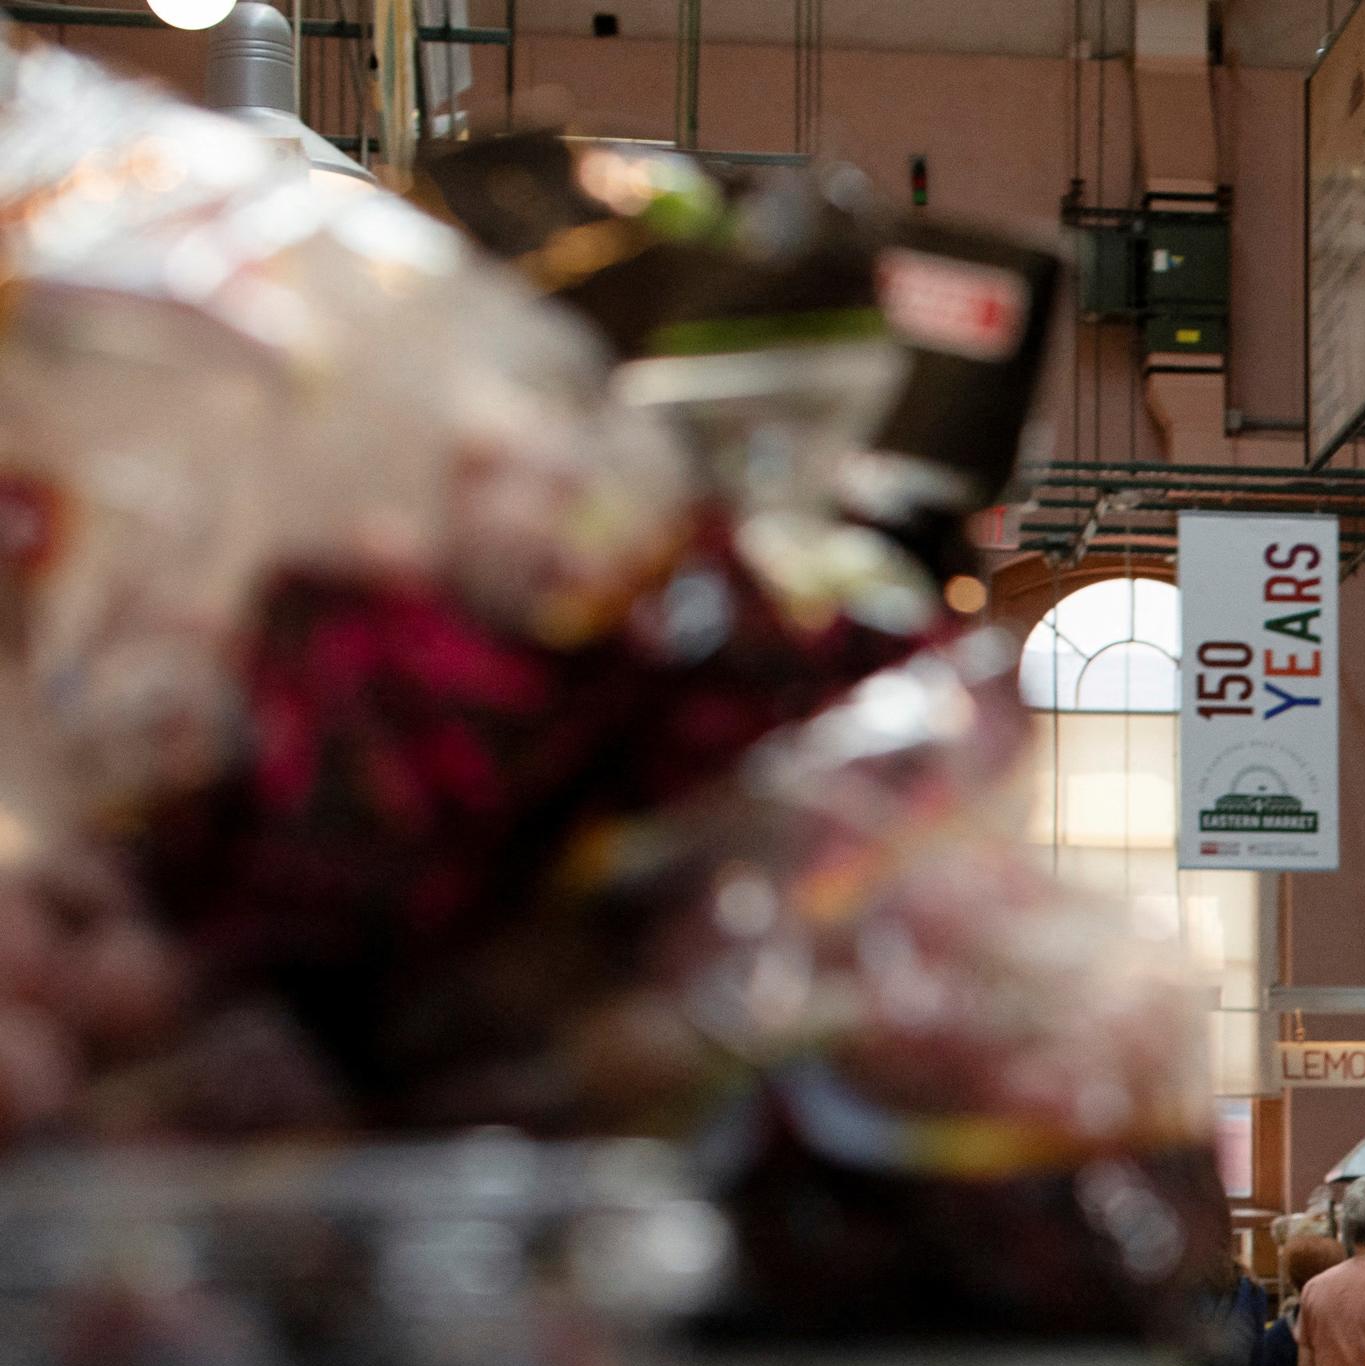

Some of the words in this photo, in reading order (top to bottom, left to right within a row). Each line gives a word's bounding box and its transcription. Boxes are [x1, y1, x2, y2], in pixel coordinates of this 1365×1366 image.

[1264, 541, 1321, 720] YEARS
[1196, 640, 1254, 720] 150
[1202, 814, 1261, 829] EASTERN
[1262, 815, 1315, 829] MARKET
